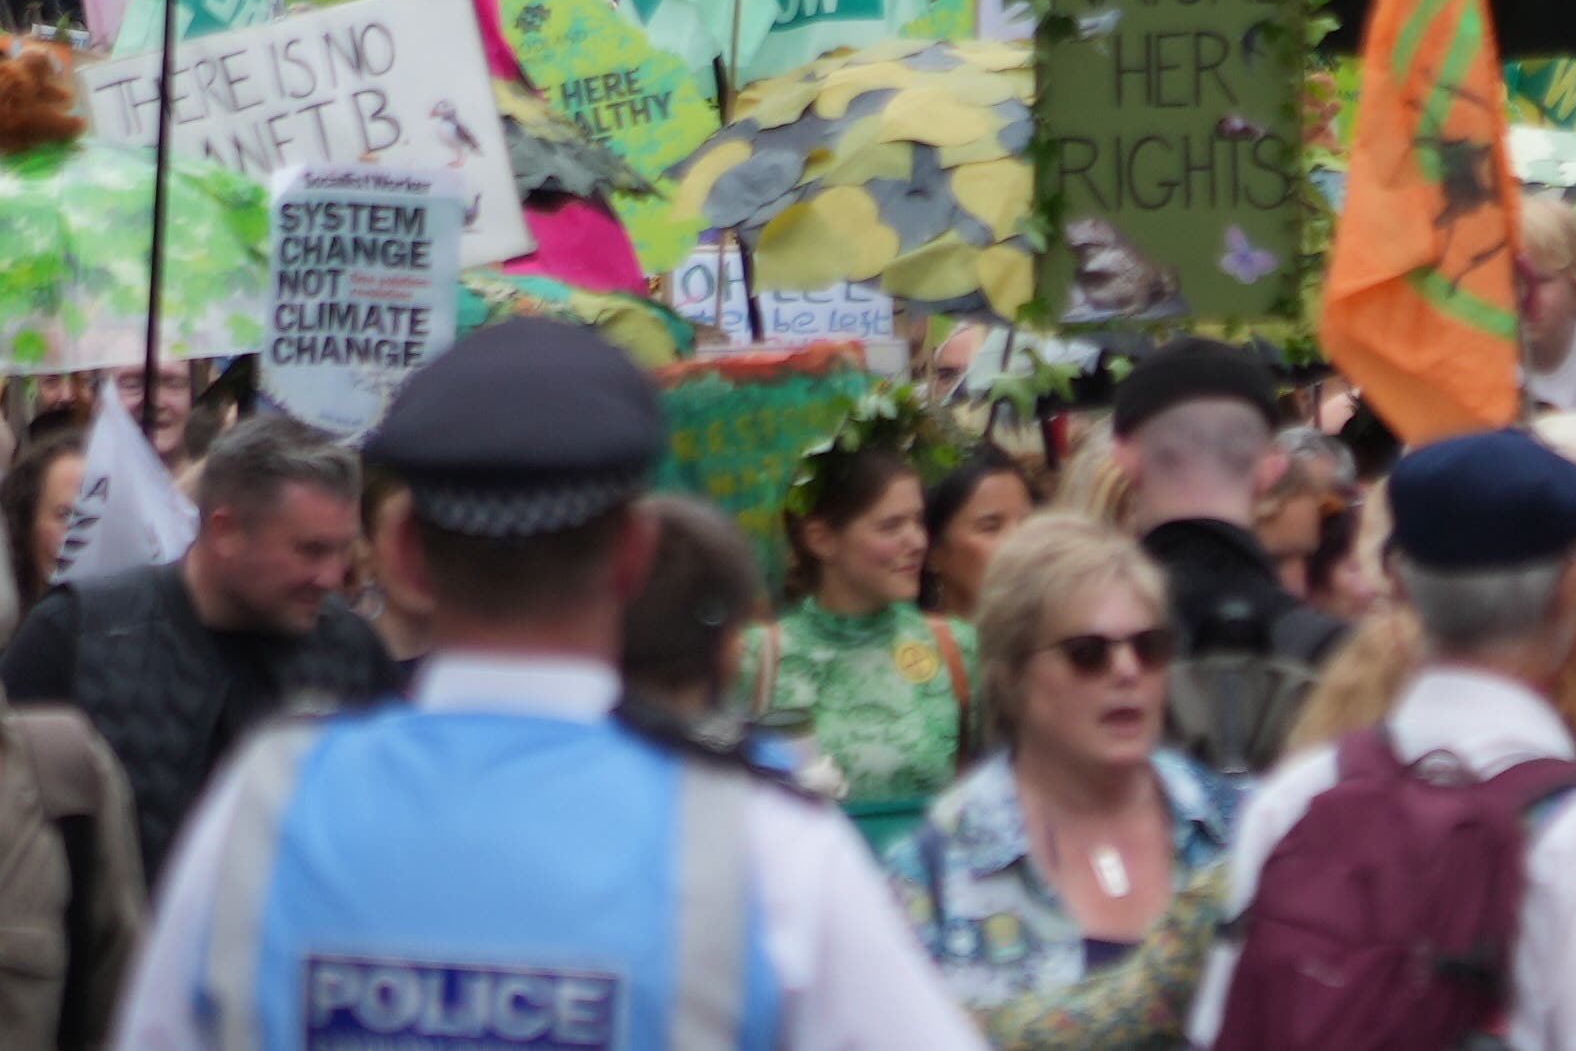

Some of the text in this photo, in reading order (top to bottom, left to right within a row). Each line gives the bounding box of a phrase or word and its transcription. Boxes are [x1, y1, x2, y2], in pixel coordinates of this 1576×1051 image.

[95, 22, 395, 137] THERE IS NO
[560, 68, 643, 110] HERE
[1112, 30, 1240, 109] HER
[573, 90, 673, 137] ALTHY
[200, 100, 336, 172] ANET
[1056, 133, 1291, 213] RIGHTS
[280, 201, 427, 237] SYSTEM
[279, 233, 434, 270] CHANGE
[277, 268, 346, 299] NOT
[274, 301, 433, 337] CLIMATE
[773, 309, 816, 334] be
[272, 334, 426, 368] CHANGE
[310, 962, 612, 1048] POLICE
